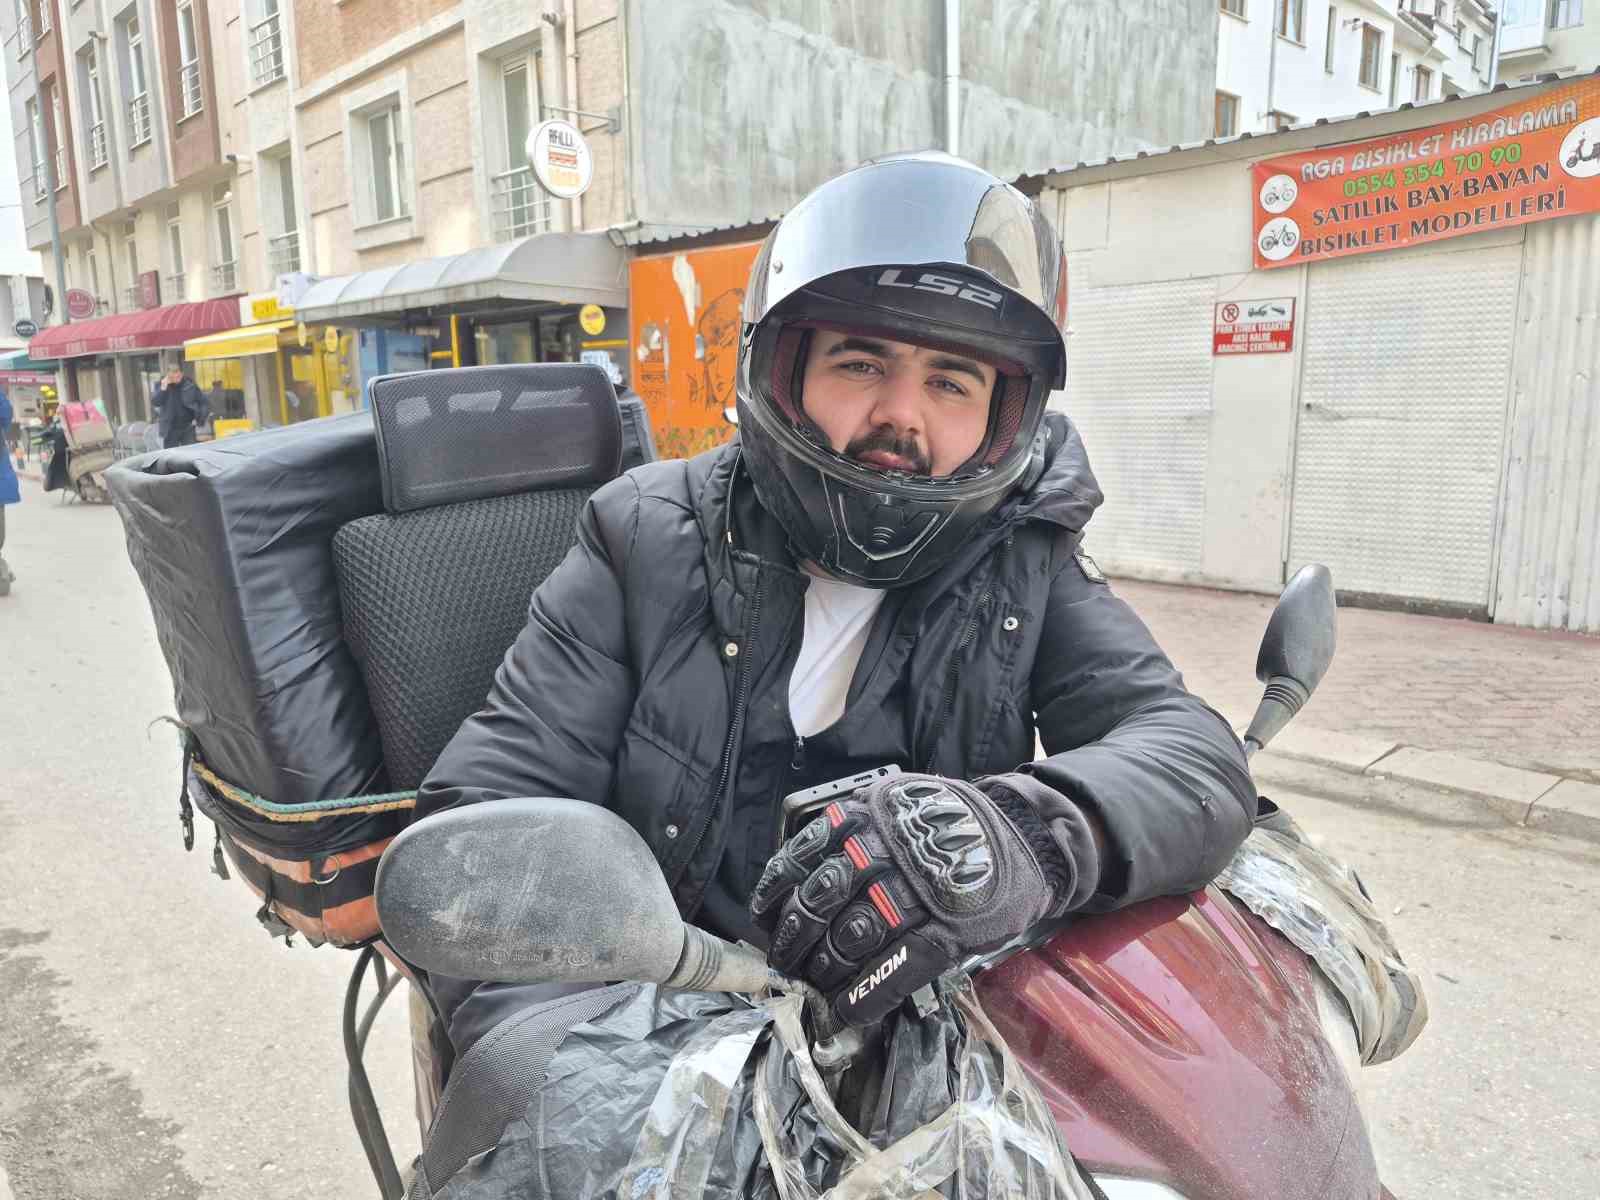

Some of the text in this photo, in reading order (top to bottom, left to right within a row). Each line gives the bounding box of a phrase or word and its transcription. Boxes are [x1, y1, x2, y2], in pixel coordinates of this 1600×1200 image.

[1343, 142, 1521, 197] 0554 354 70 90
[1312, 194, 1400, 226] SATILIK
[1411, 184, 1566, 238] MODELLERİ
[877, 268, 1003, 310] LS2
[848, 944, 907, 1006] VENOM
